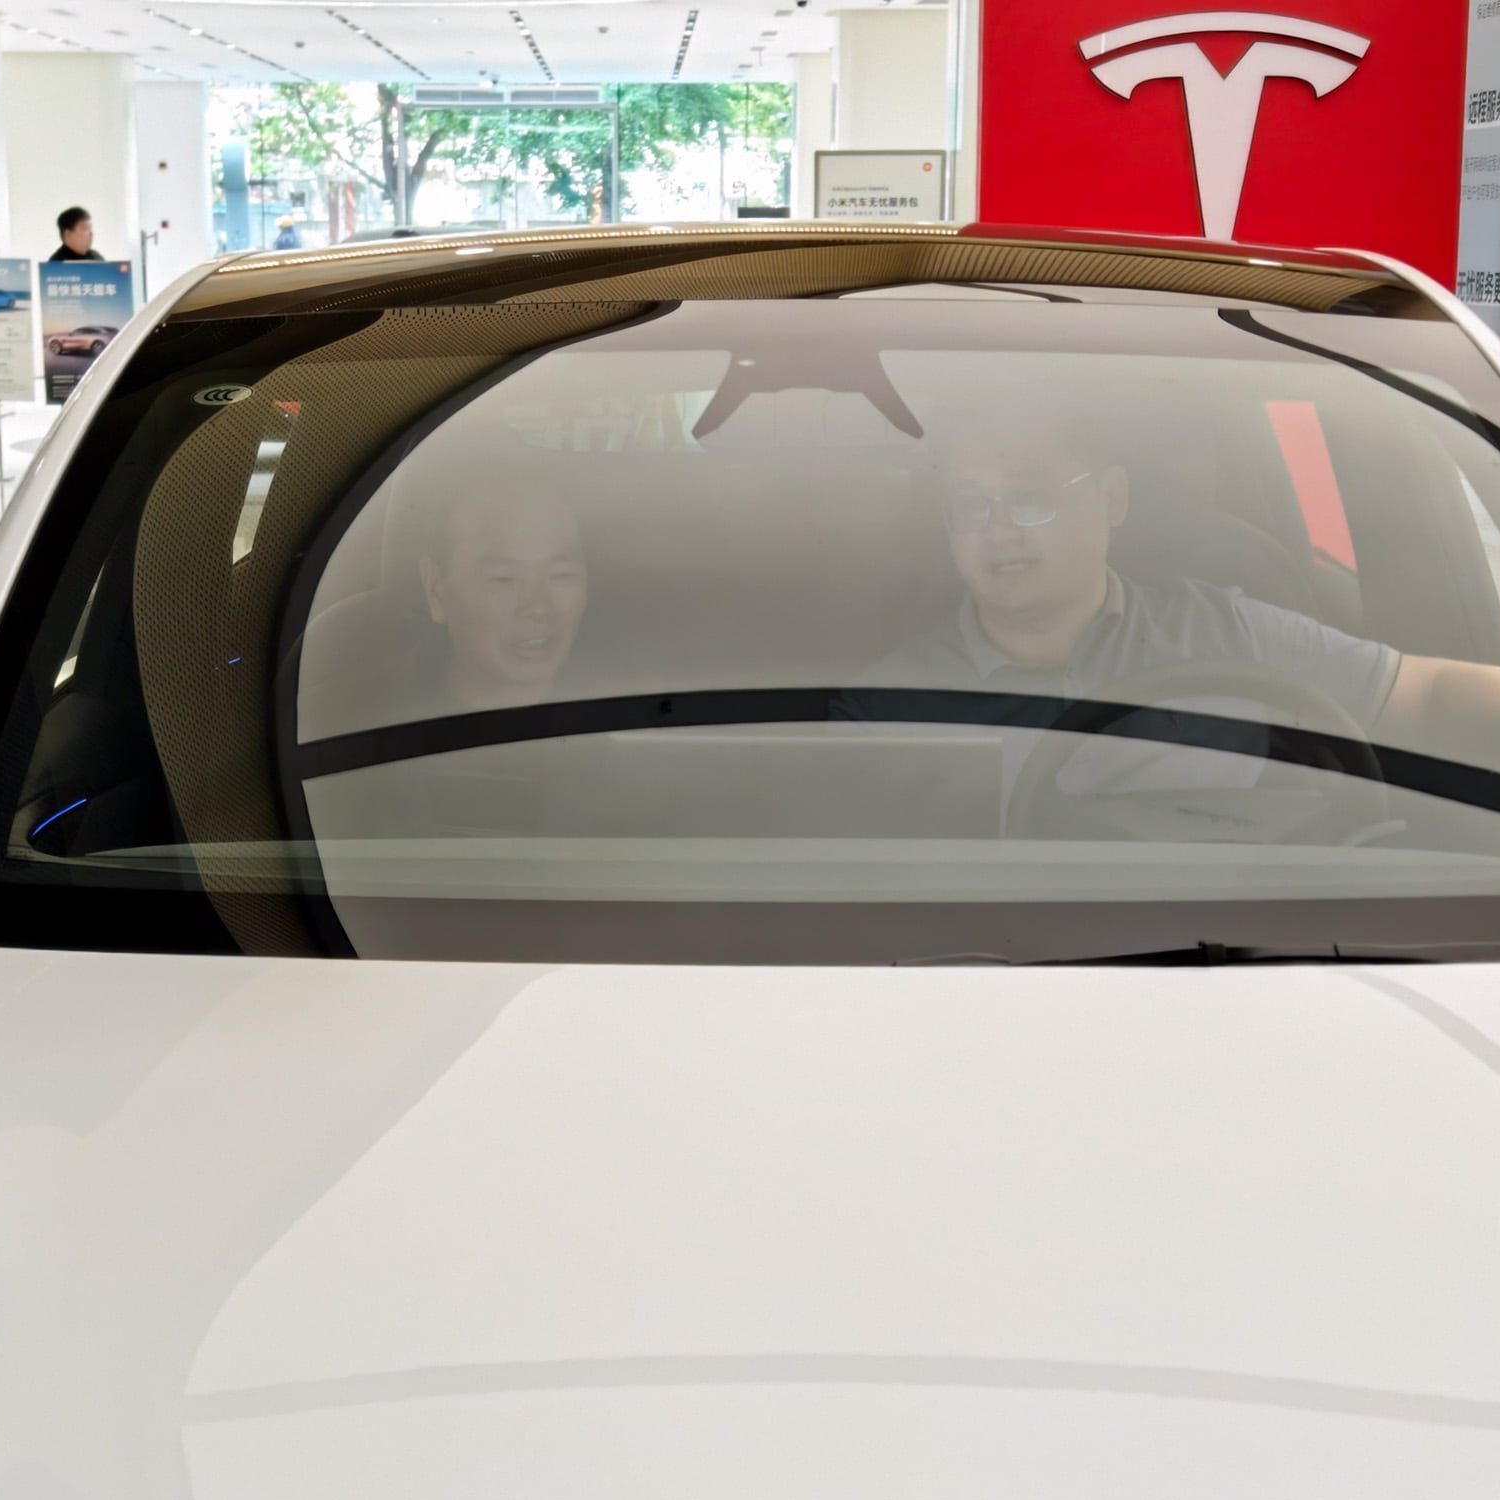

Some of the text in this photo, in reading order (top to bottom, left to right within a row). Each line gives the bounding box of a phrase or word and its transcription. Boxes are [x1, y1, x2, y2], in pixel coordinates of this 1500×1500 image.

[828, 196, 918, 208] 小米汽车无忧服务包
